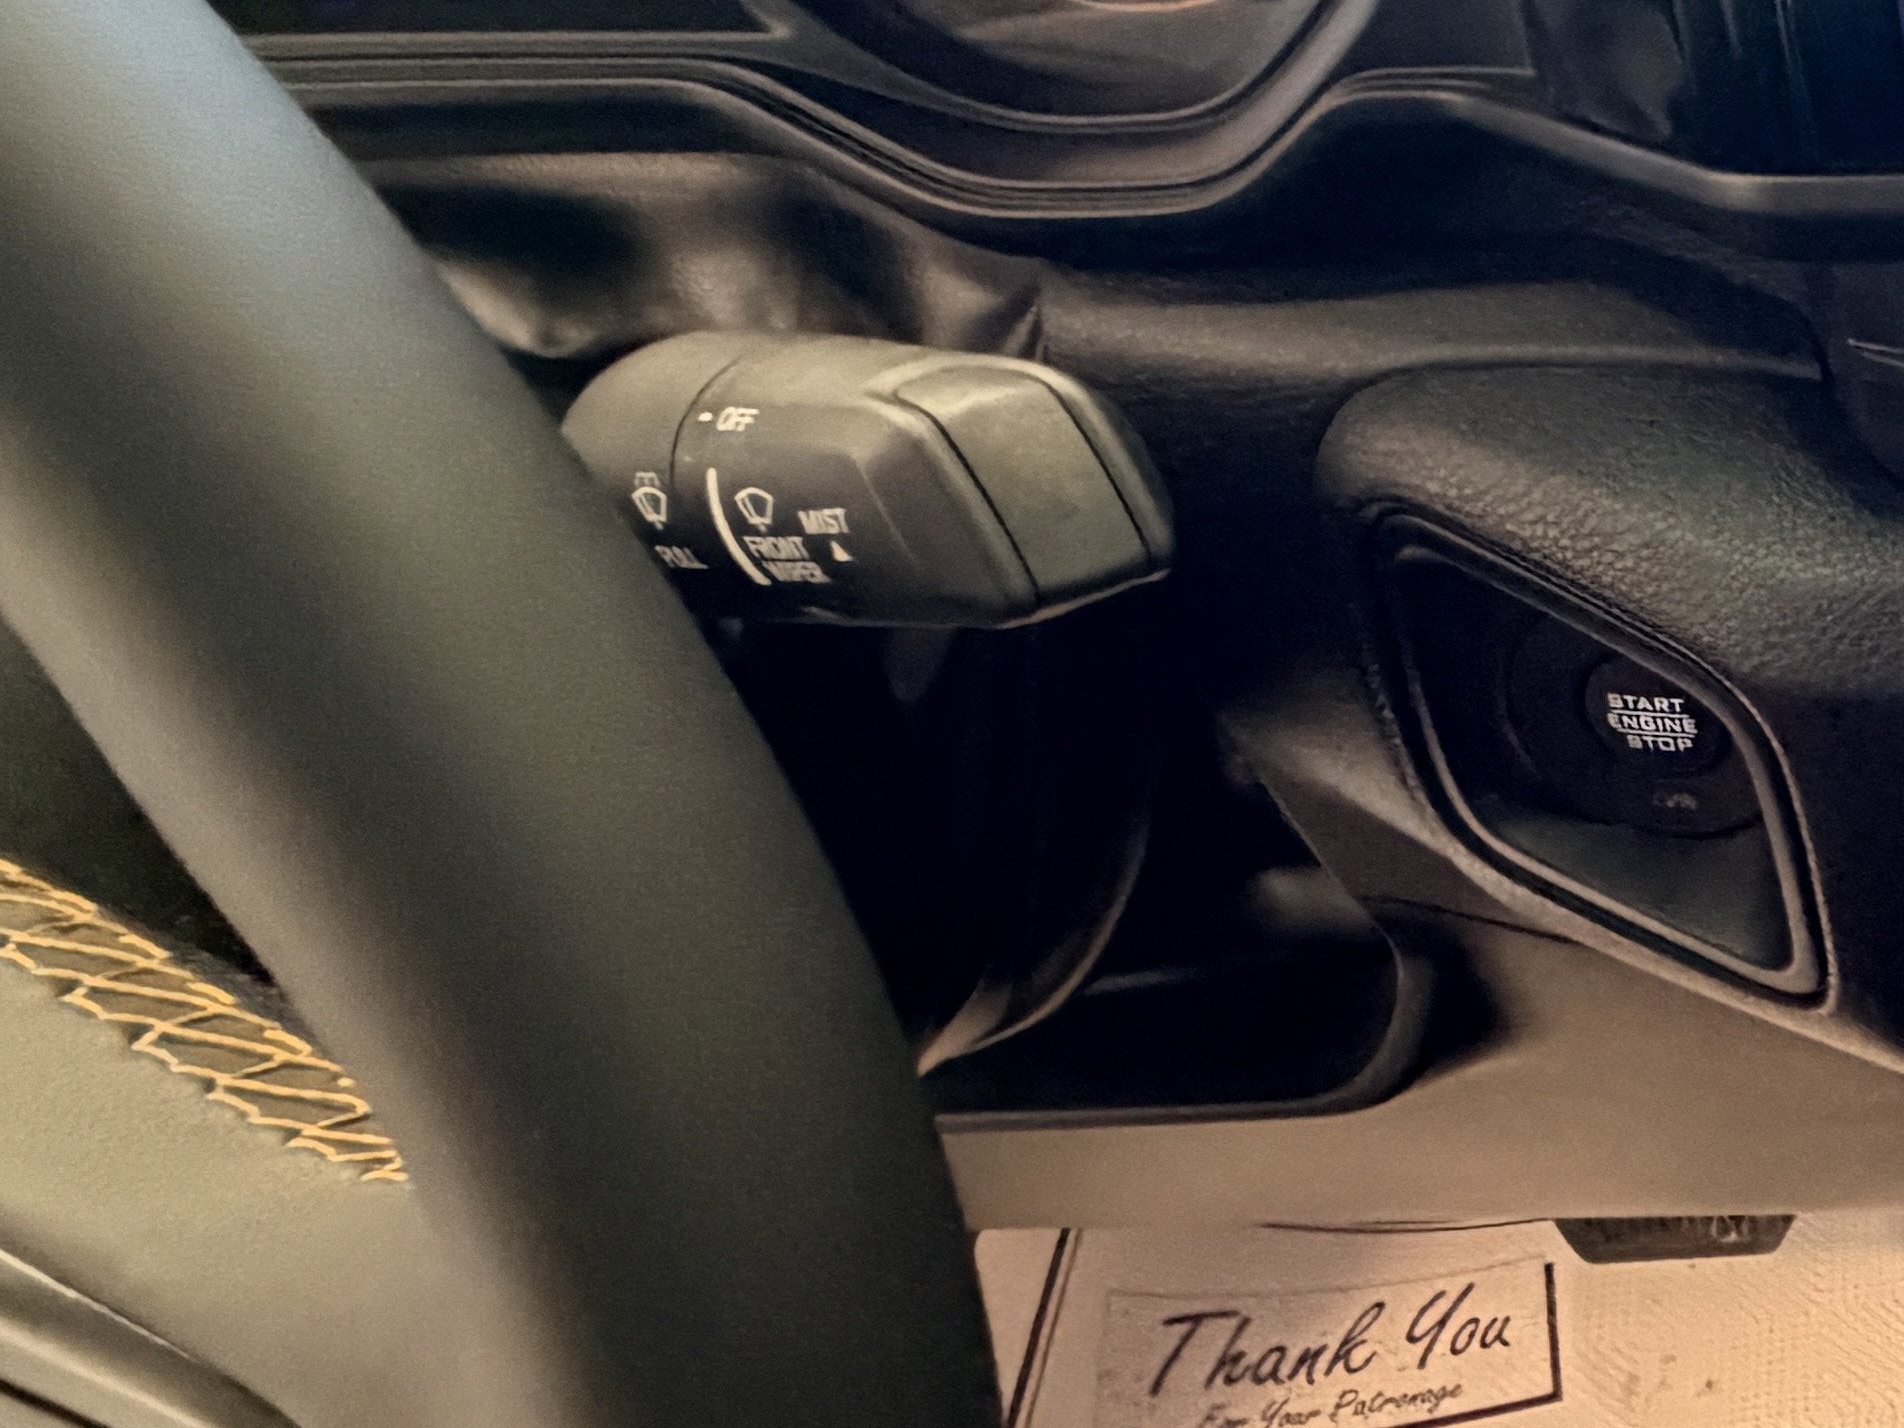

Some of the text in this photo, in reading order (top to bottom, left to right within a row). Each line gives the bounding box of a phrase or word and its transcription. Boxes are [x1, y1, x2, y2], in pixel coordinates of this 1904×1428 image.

[716, 406, 760, 432] OFF
[797, 507, 849, 534] MIST
[1607, 693, 1684, 713] START
[1607, 712, 1698, 734] ENGINE
[1627, 735, 1693, 752] STOP
[1149, 1282, 1512, 1398] Thank You
